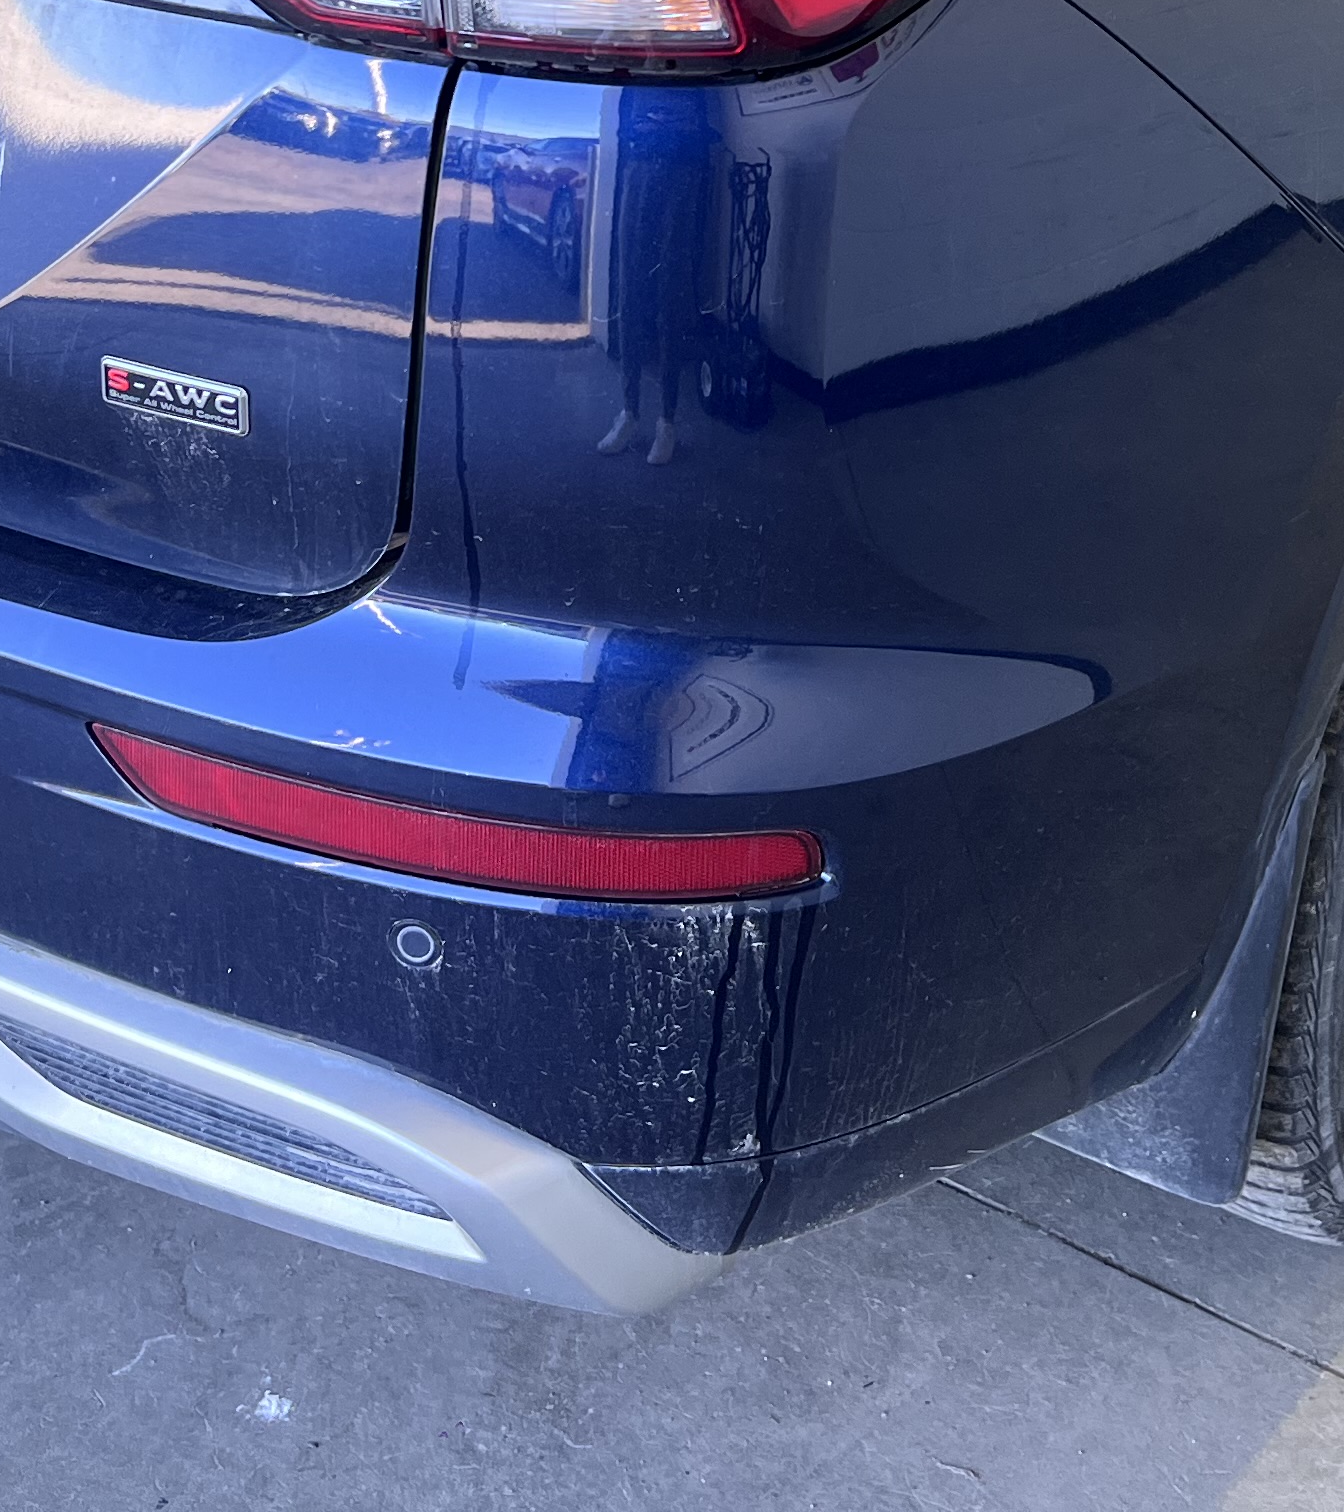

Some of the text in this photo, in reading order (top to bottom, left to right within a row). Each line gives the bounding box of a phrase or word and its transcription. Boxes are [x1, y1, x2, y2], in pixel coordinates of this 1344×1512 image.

[107, 368, 237, 415] S-AWC
[109, 389, 238, 426] Super All Wheel Control
